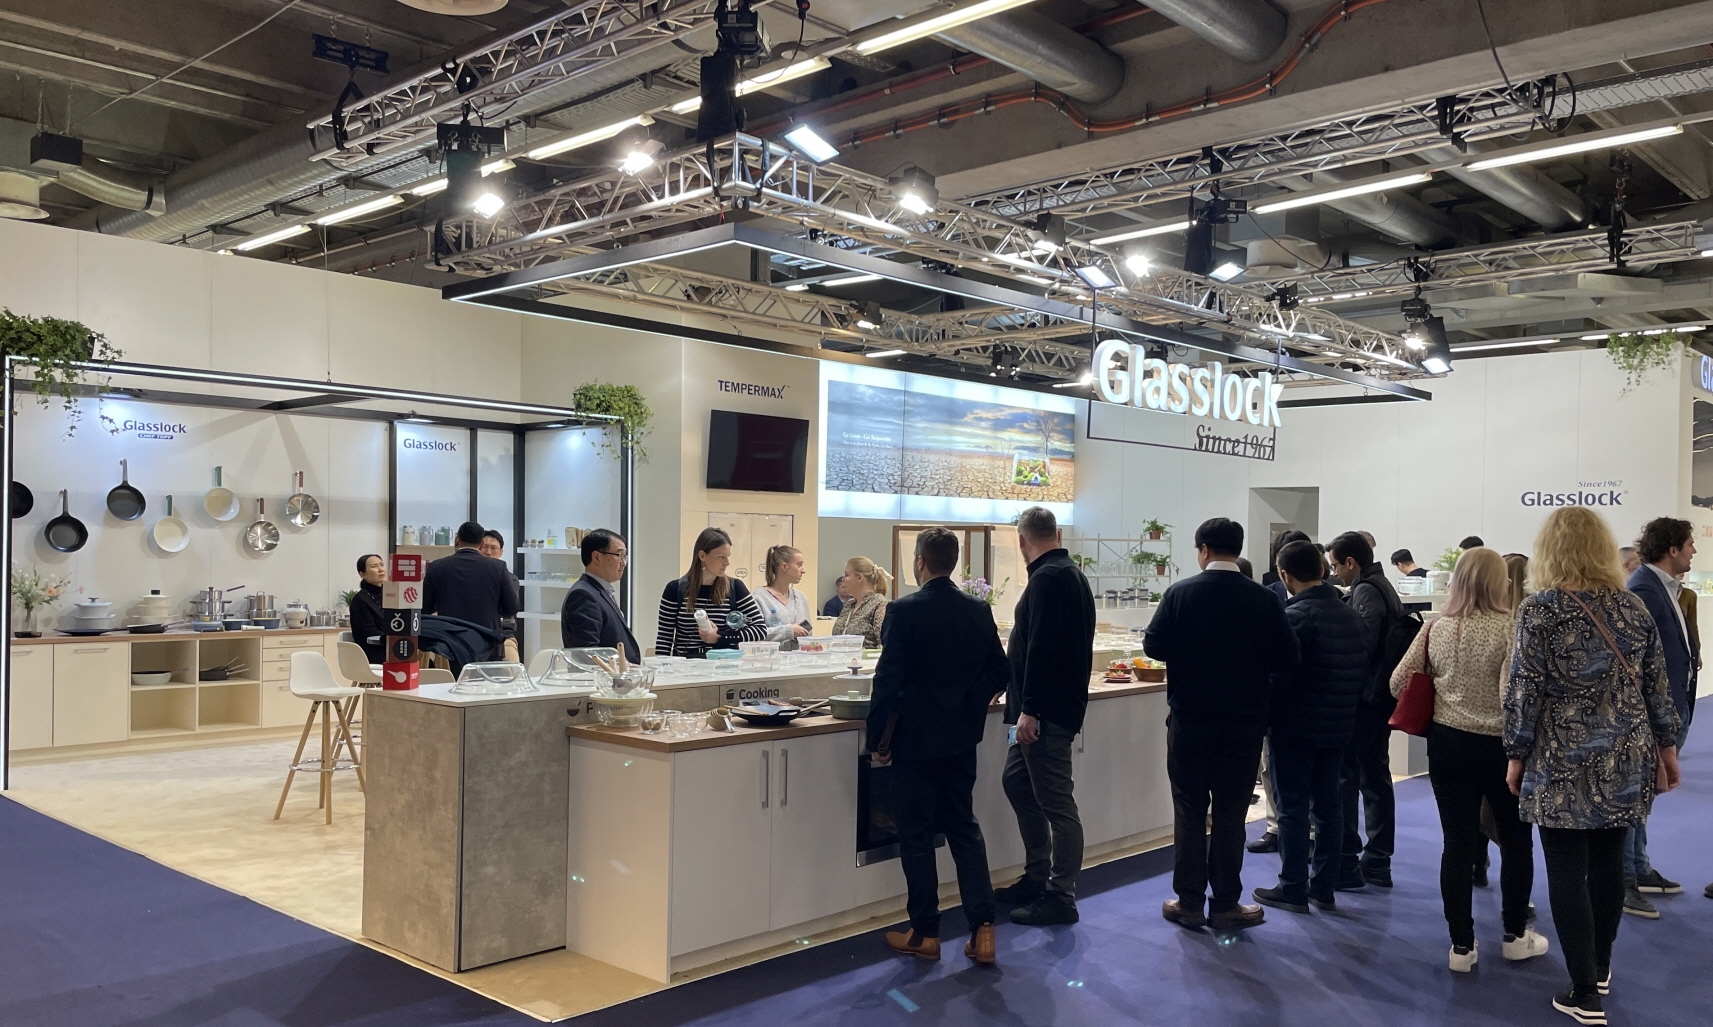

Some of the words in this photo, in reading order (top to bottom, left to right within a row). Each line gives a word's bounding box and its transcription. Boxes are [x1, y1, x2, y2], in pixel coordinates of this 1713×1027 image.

[717, 379, 786, 400] TEMPERMAX
[1092, 339, 1285, 428] Glasslock
[123, 419, 187, 434] Glasslock
[403, 438, 457, 452] Glasslock
[1578, 480, 1622, 488] Since1967
[1520, 490, 1623, 507] Glasslock
[739, 687, 780, 699] Cooking
